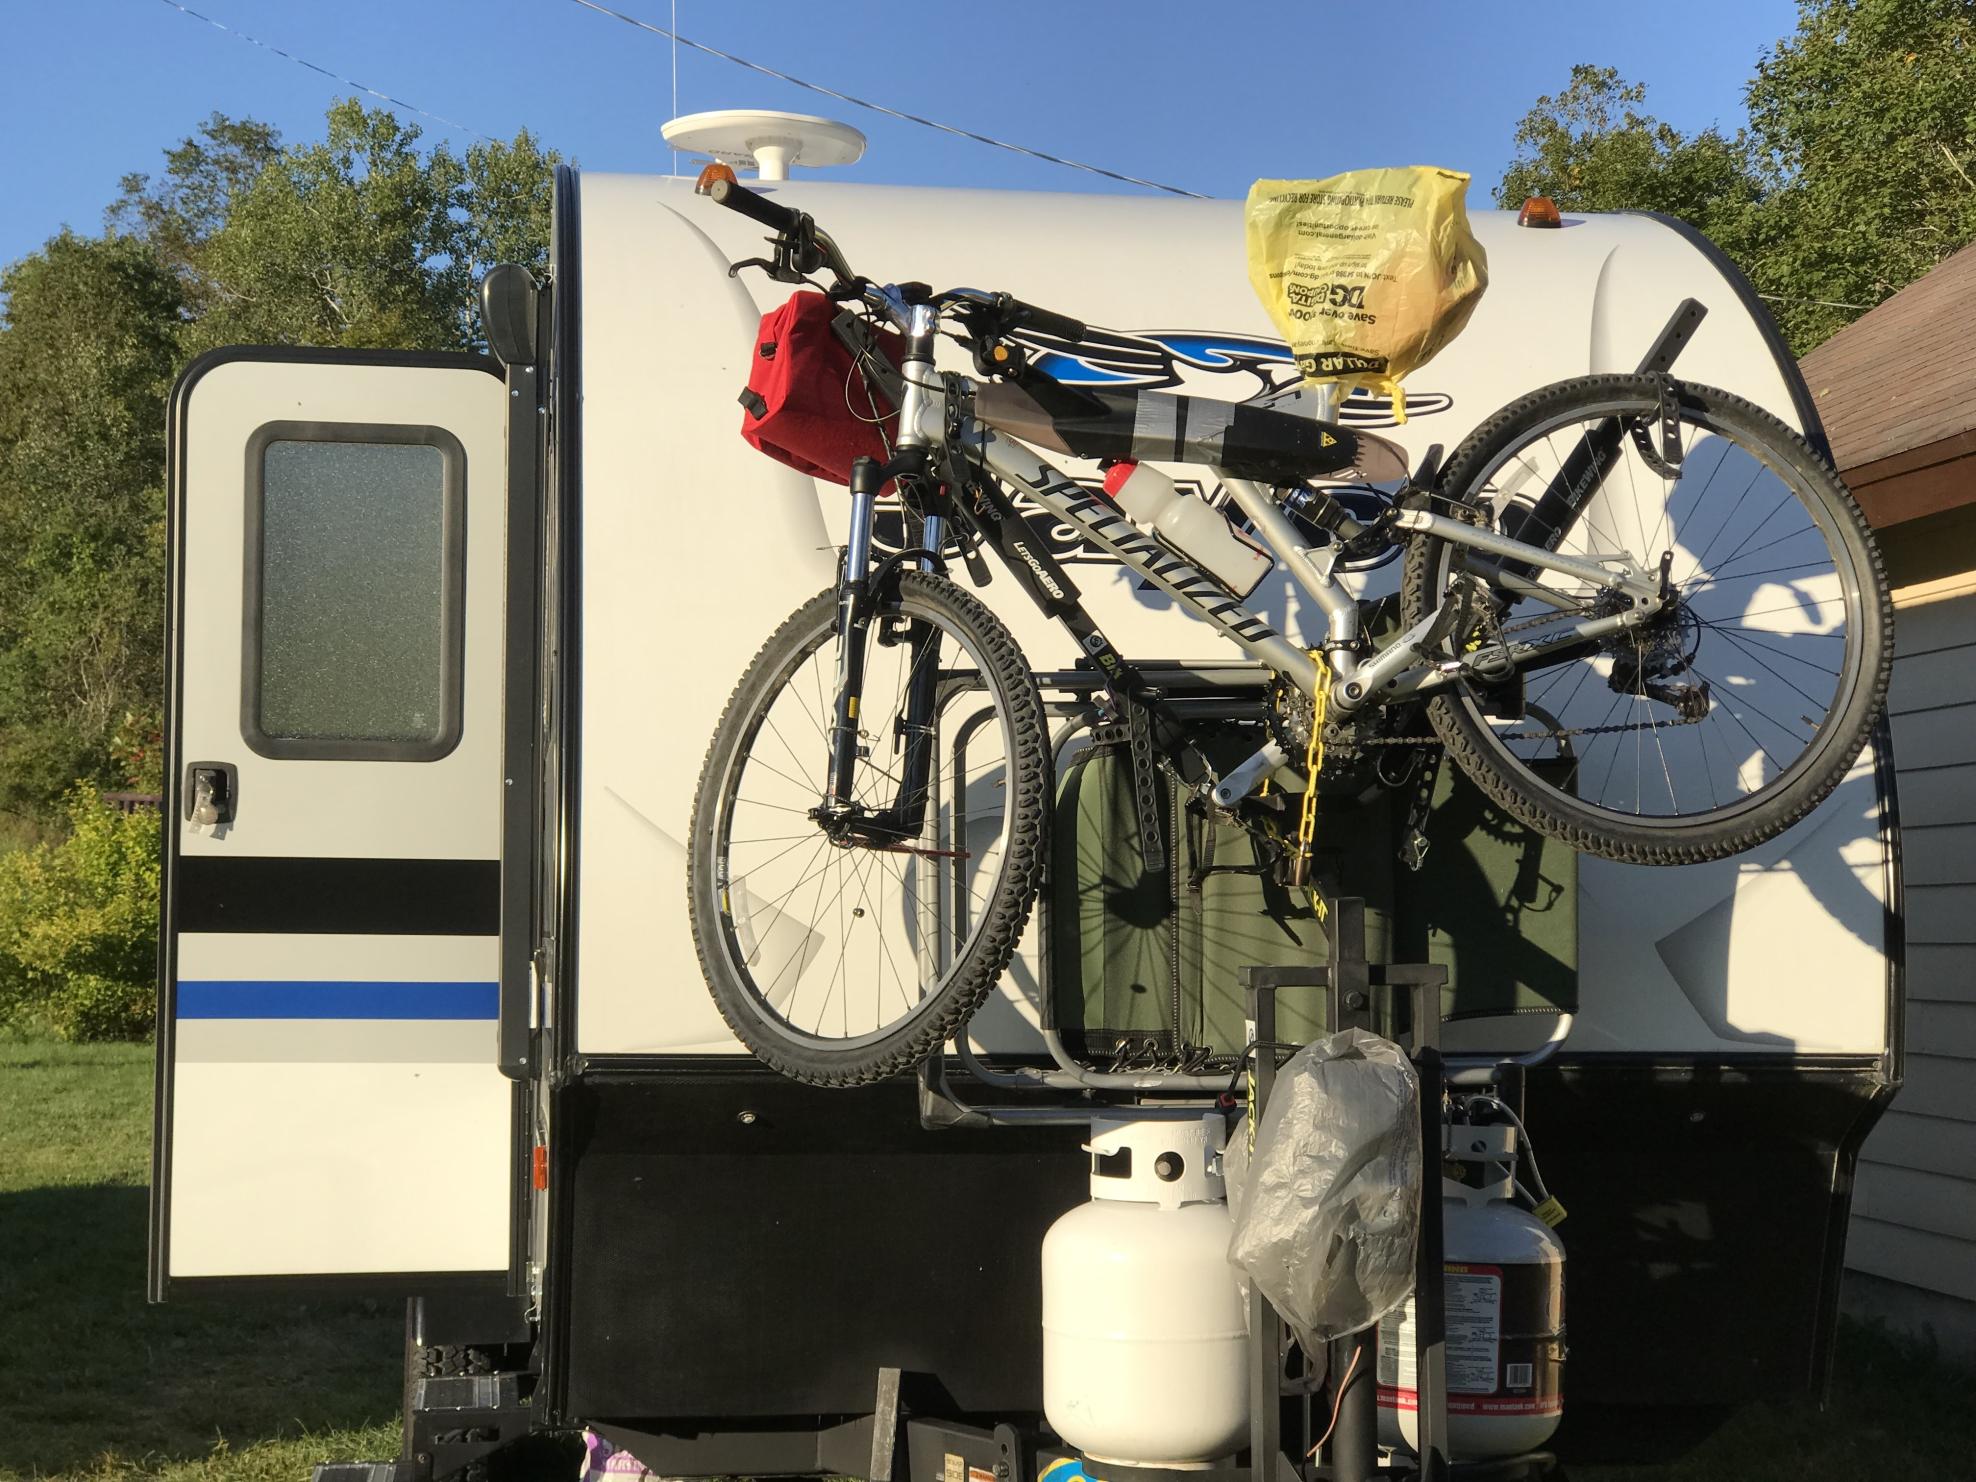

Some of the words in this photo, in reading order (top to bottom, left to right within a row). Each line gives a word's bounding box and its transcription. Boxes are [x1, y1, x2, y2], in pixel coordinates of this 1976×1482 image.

[1329, 284, 1366, 310] DG
[1348, 312, 1376, 325] Save
[1016, 463, 1280, 643] SPECIALIZED
